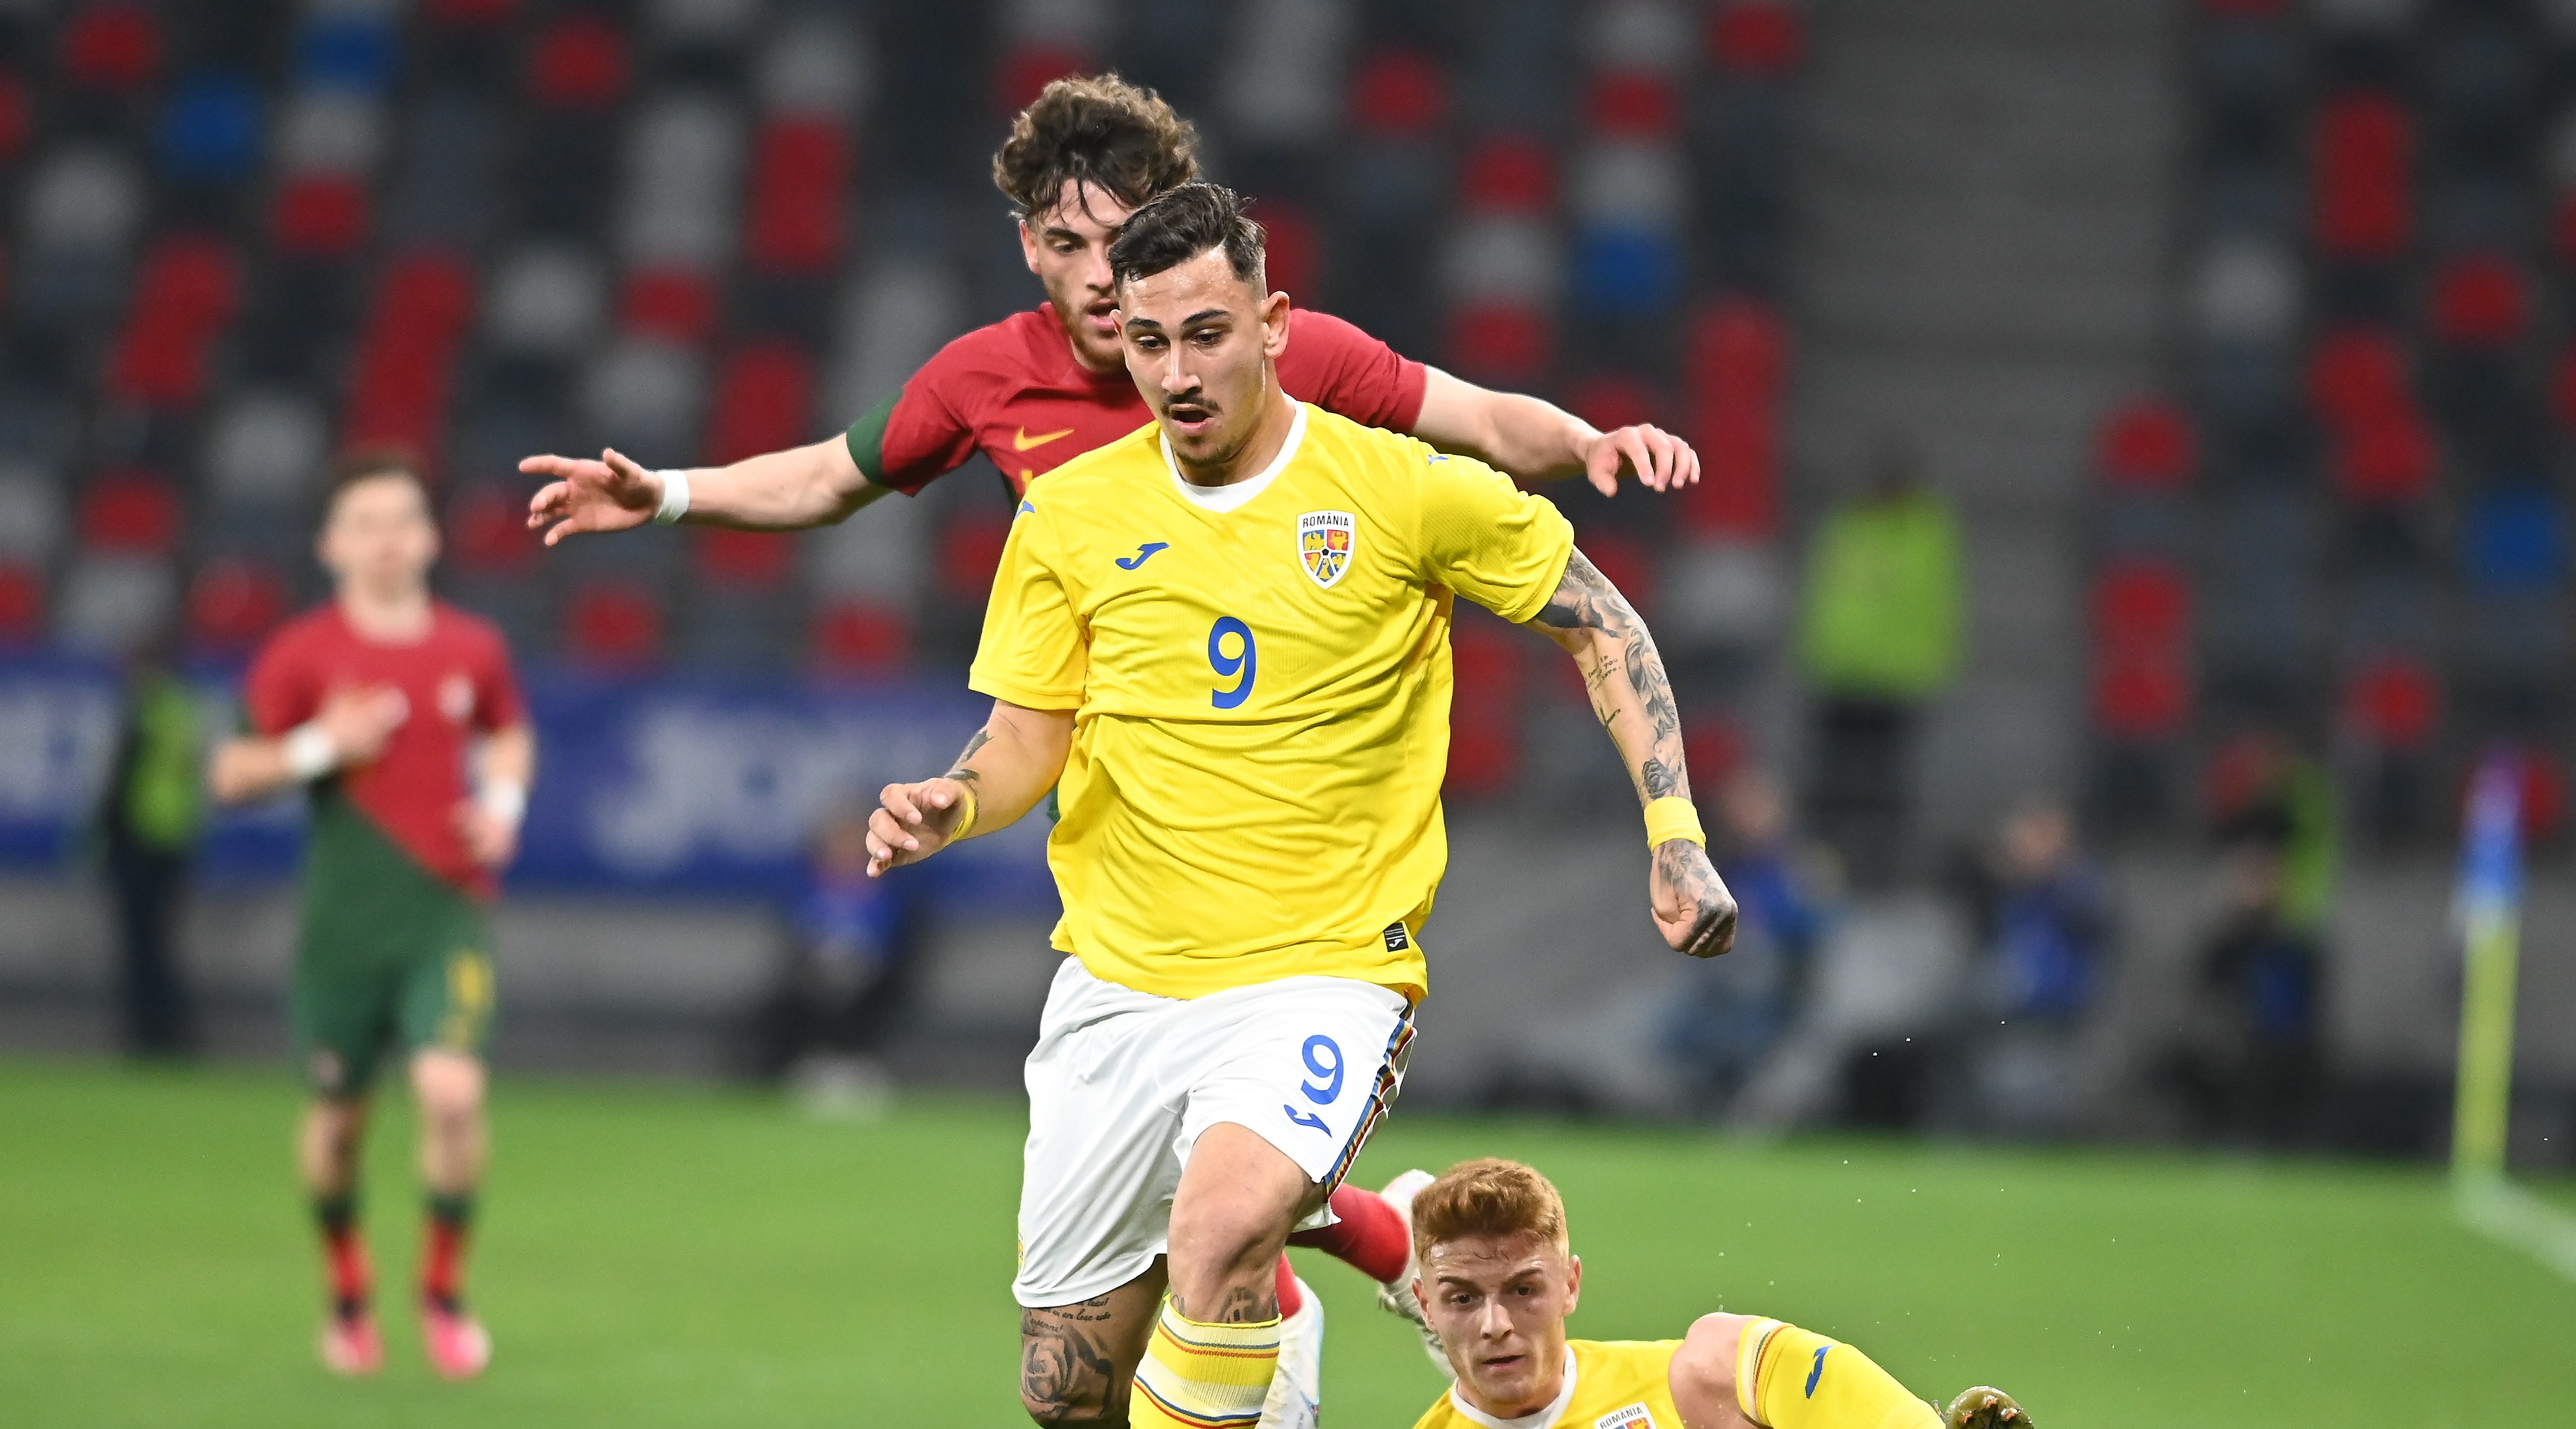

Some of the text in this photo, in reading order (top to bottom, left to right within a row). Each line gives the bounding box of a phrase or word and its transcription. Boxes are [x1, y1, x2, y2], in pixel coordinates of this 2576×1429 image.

[1303, 512, 1349, 528] ROMÂNIA
[1208, 616, 1257, 709] 9
[1300, 1034, 1345, 1105] 9
[1600, 1406, 1644, 1429] ROMÂNIA
